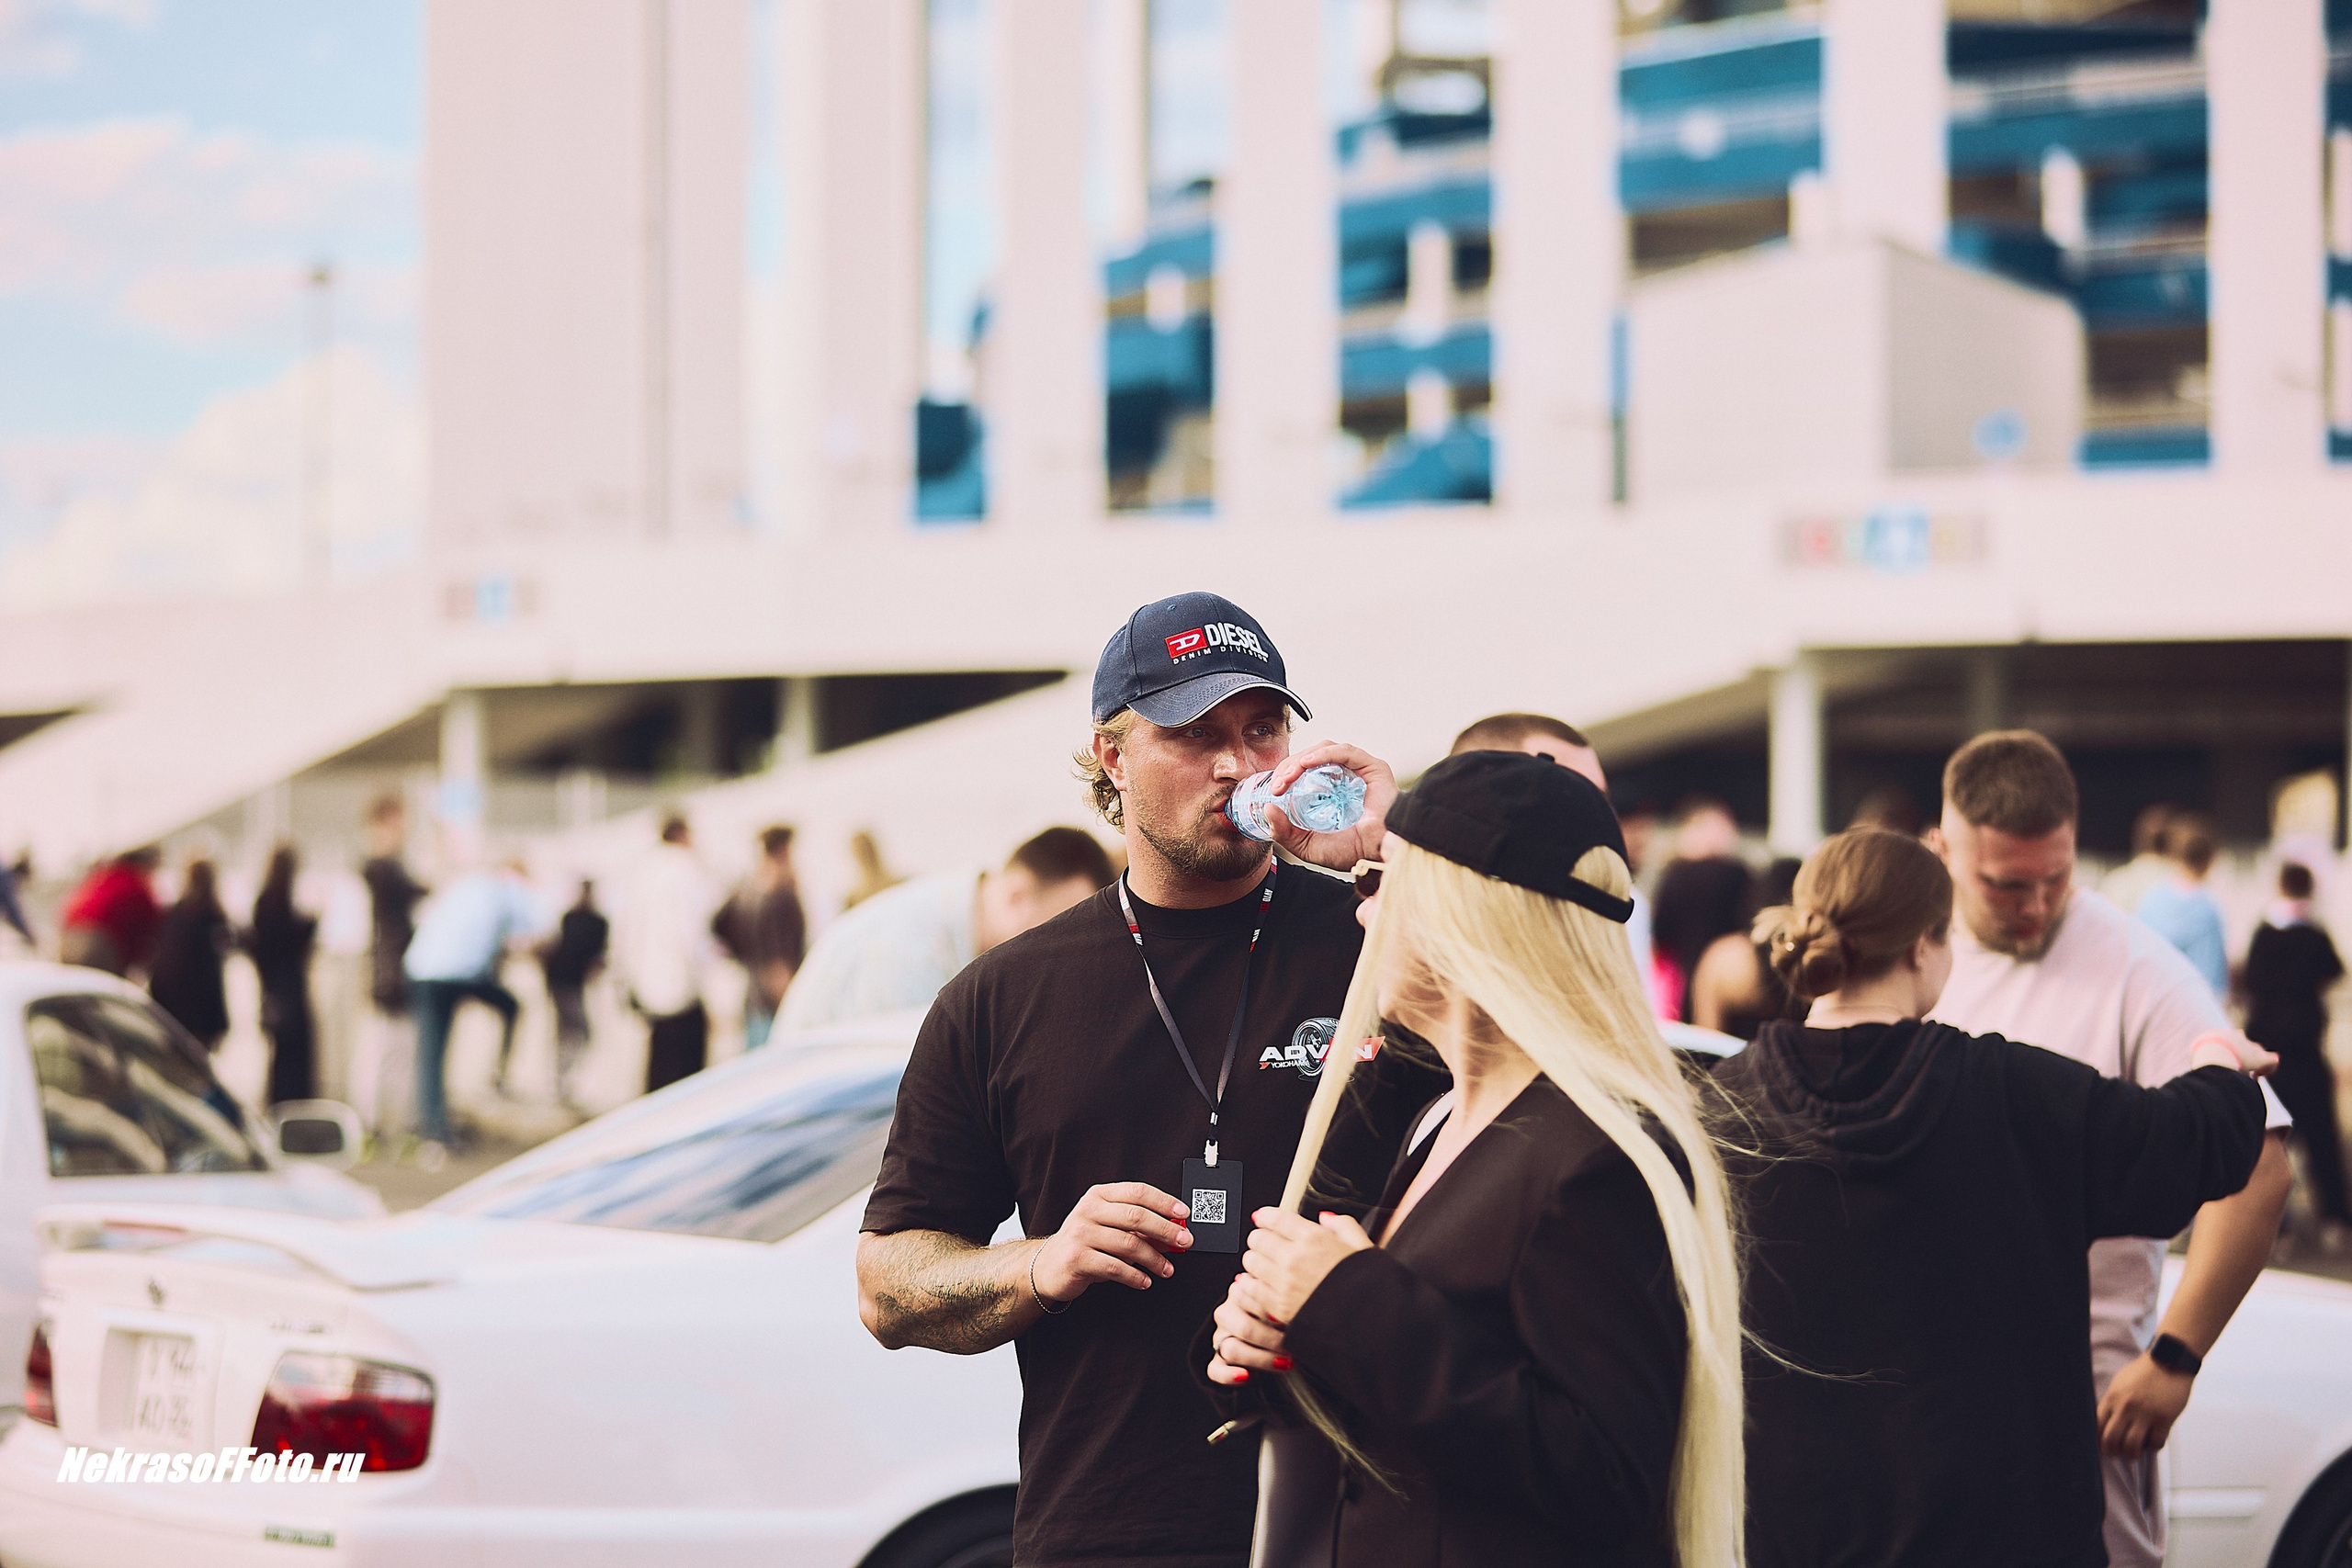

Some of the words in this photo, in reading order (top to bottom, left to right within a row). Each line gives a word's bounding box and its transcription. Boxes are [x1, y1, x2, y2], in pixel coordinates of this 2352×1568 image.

[1204, 622, 1269, 659] DIESEL
[1172, 647, 1212, 665] DENIM
[1220, 645, 1268, 663] DIVISION
[1259, 1043, 1373, 1062] ADVN
